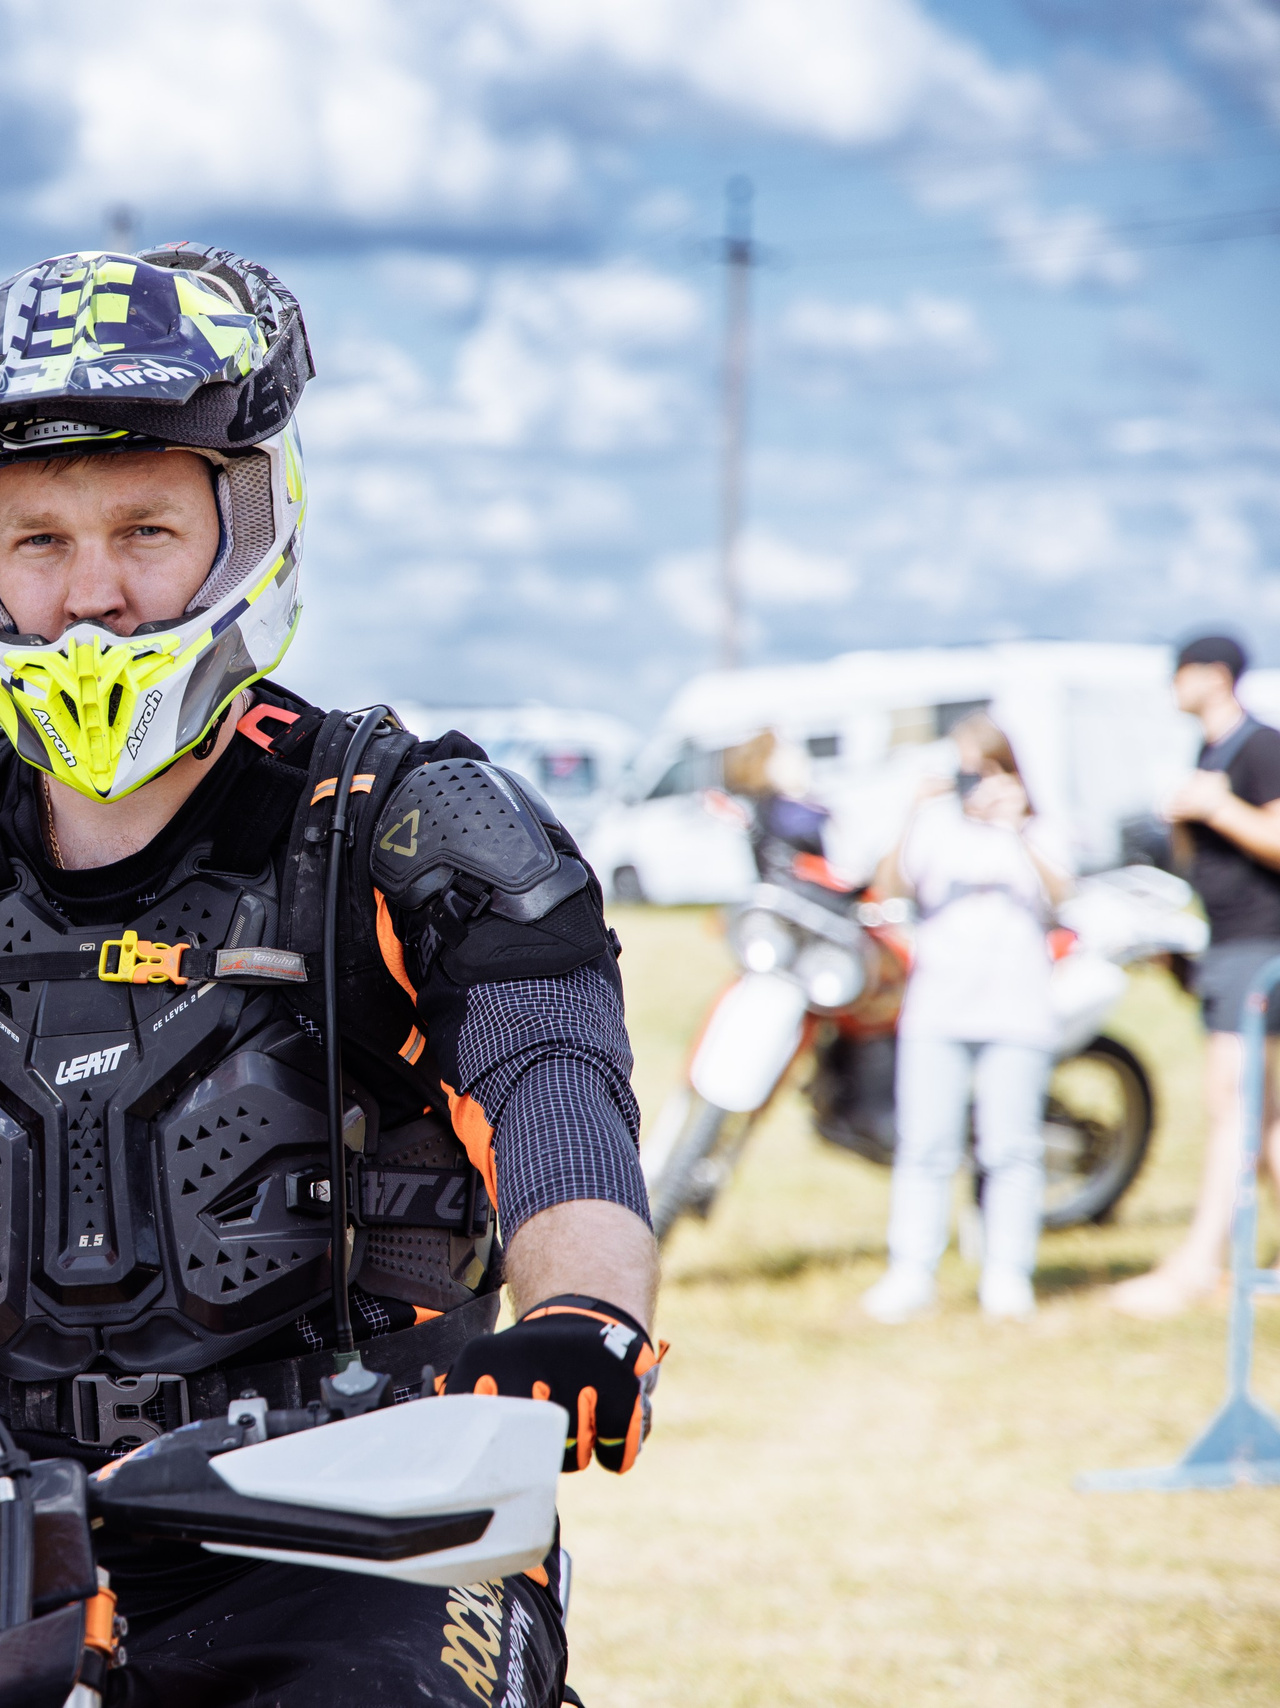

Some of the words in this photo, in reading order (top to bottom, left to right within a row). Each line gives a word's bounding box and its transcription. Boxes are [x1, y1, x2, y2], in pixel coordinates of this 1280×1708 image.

[86, 359, 197, 390] Airoh
[34, 424, 89, 436] HELMET
[30, 707, 78, 768] Airoh
[124, 689, 164, 761] Airoh
[164, 1000, 190, 1023] LEVEL
[54, 1042, 130, 1086] LEATT
[78, 1233, 105, 1248] 6.5
